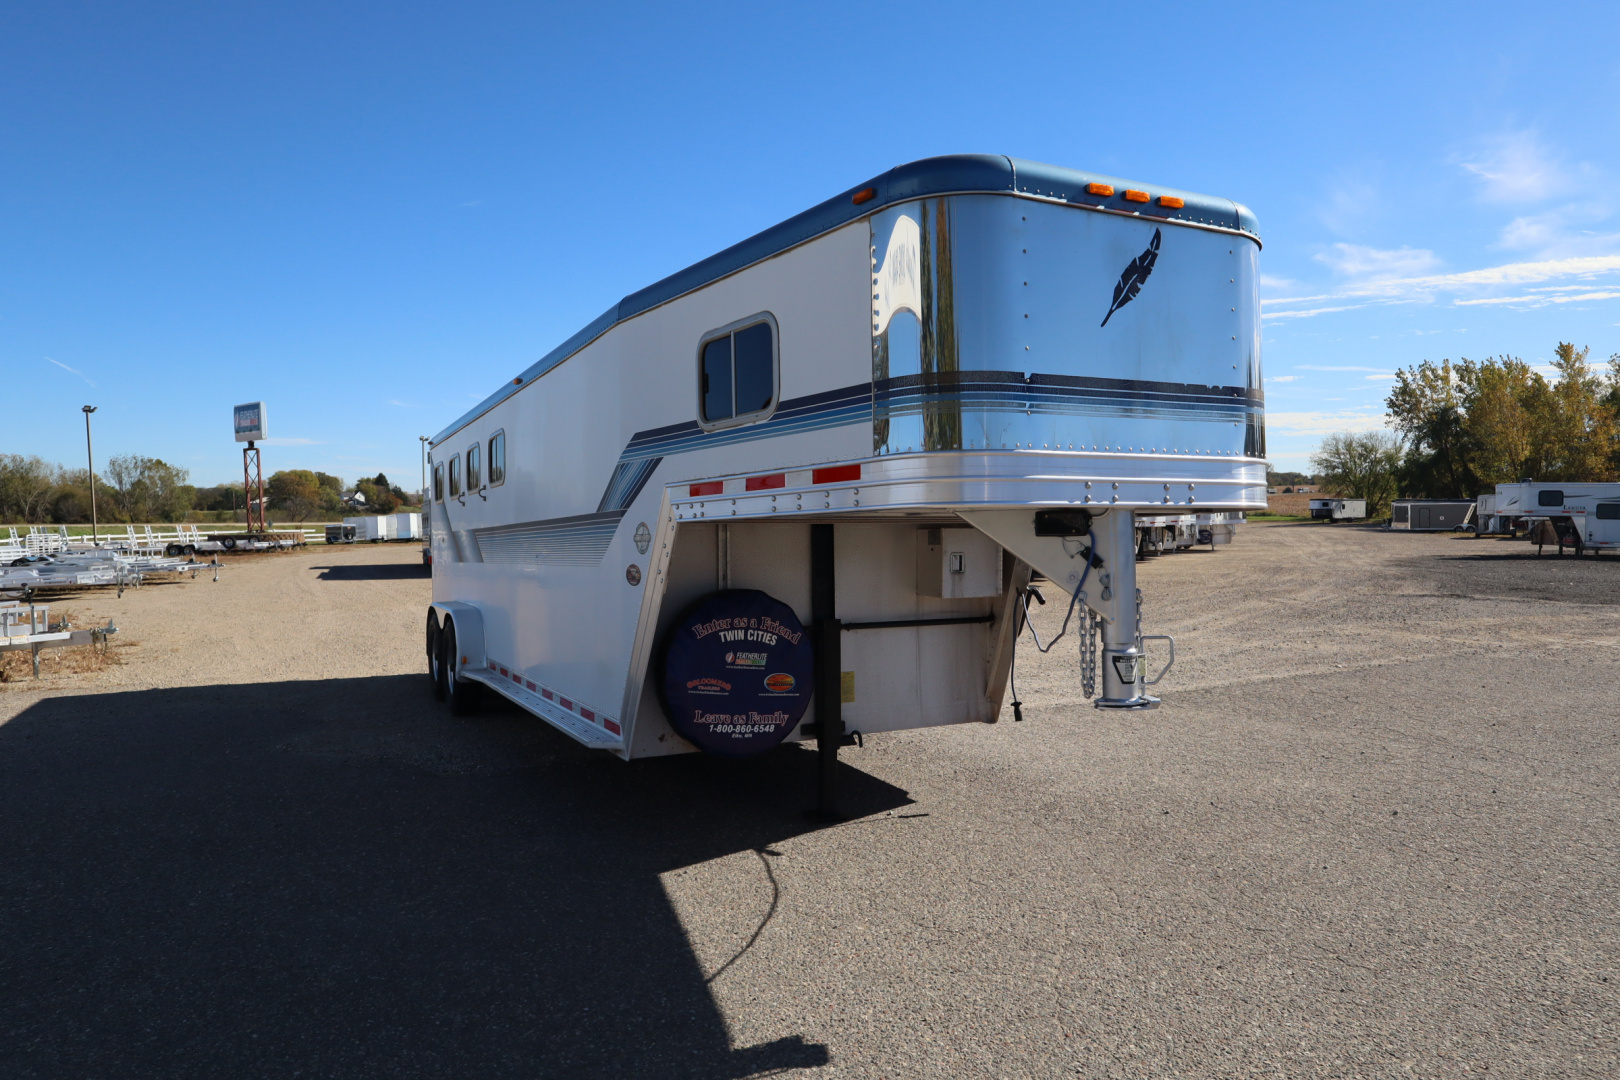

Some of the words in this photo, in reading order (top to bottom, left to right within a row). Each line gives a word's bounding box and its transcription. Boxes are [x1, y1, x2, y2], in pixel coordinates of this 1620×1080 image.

[692, 618, 731, 639] Enter
[733, 617, 748, 628] as
[749, 618, 758, 628] a
[760, 616, 802, 645] Friend
[719, 629, 745, 642] TWIN
[747, 629, 778, 646] CITIES
[736, 651, 768, 660] FEATHERLITE
[693, 710, 731, 724] Leave
[733, 714, 747, 724] as
[748, 711, 789, 727] Family
[709, 724, 775, 733] 1-800-860-6548
